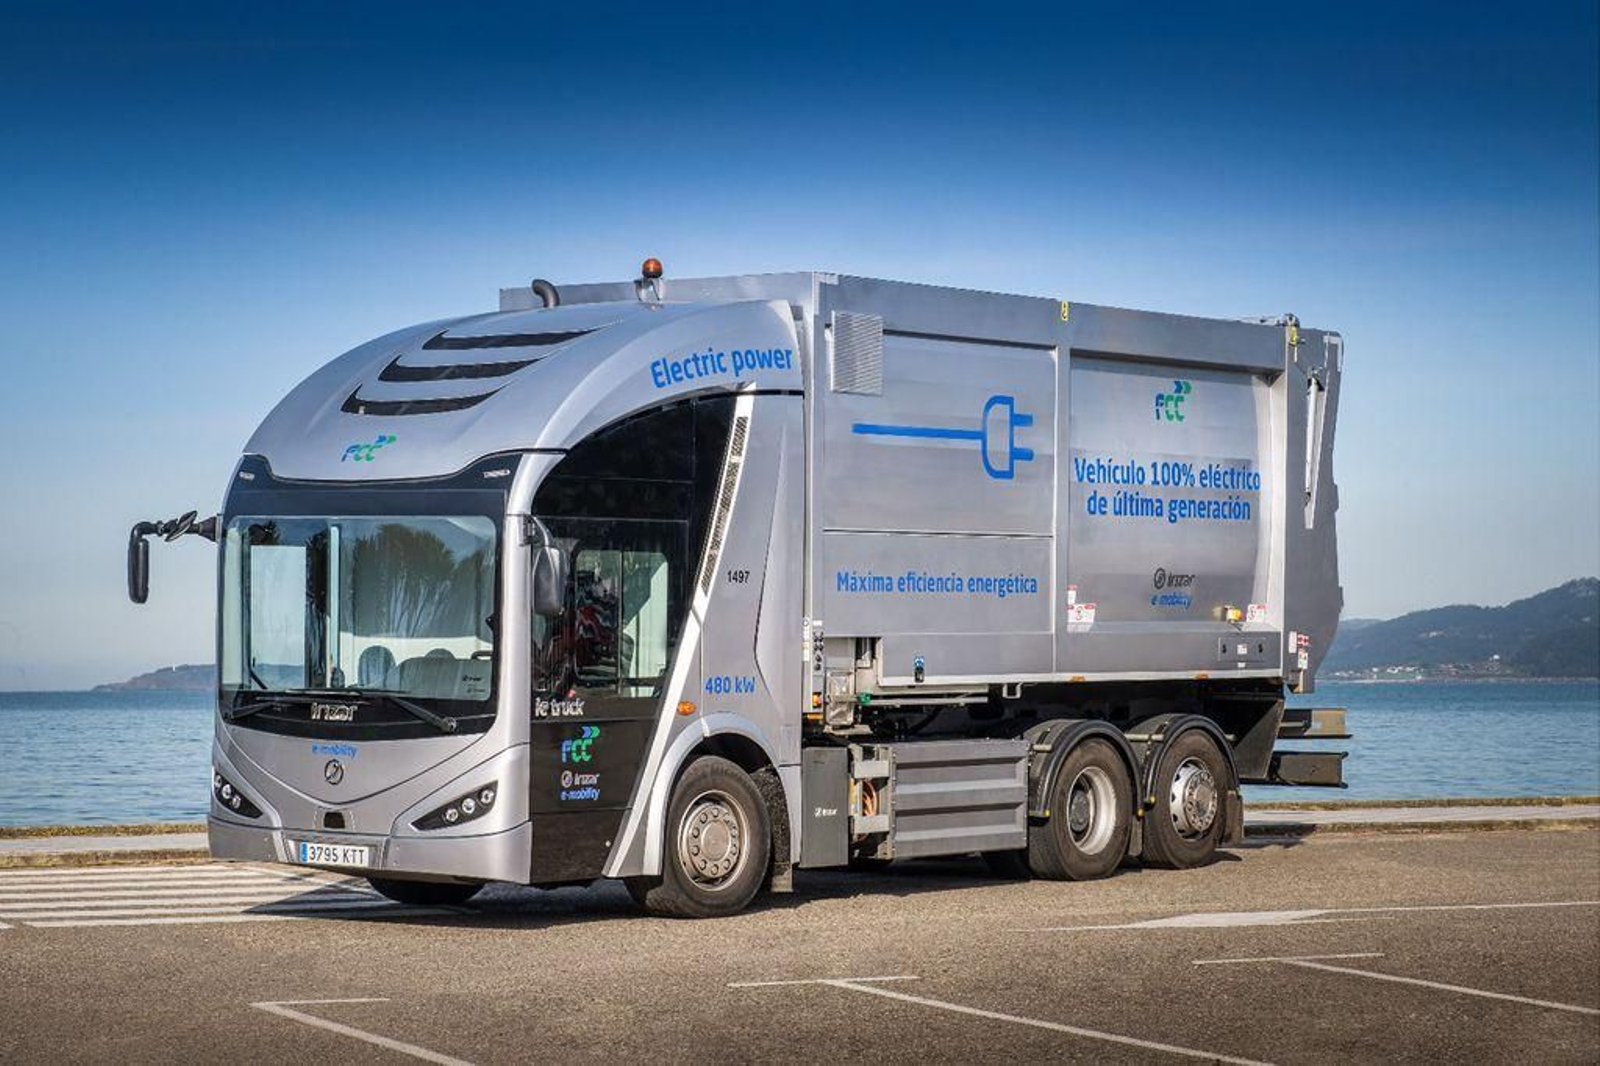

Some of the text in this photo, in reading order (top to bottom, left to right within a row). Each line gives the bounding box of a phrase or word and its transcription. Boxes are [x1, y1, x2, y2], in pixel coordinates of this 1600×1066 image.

[650, 347, 793, 389] Electric power
[1155, 393, 1185, 421] FCC
[1074, 457, 1261, 491] Vehículo 100% eléctrico
[1087, 490, 1251, 523] de última generación
[727, 570, 750, 583] 1497
[837, 570, 1038, 598] Máxima eficiencia energética
[705, 676, 755, 695] 480 kW
[550, 698, 585, 716] truck
[561, 738, 593, 763] FCC
[309, 846, 339, 863] 3795
[342, 848, 365, 865] KTT
